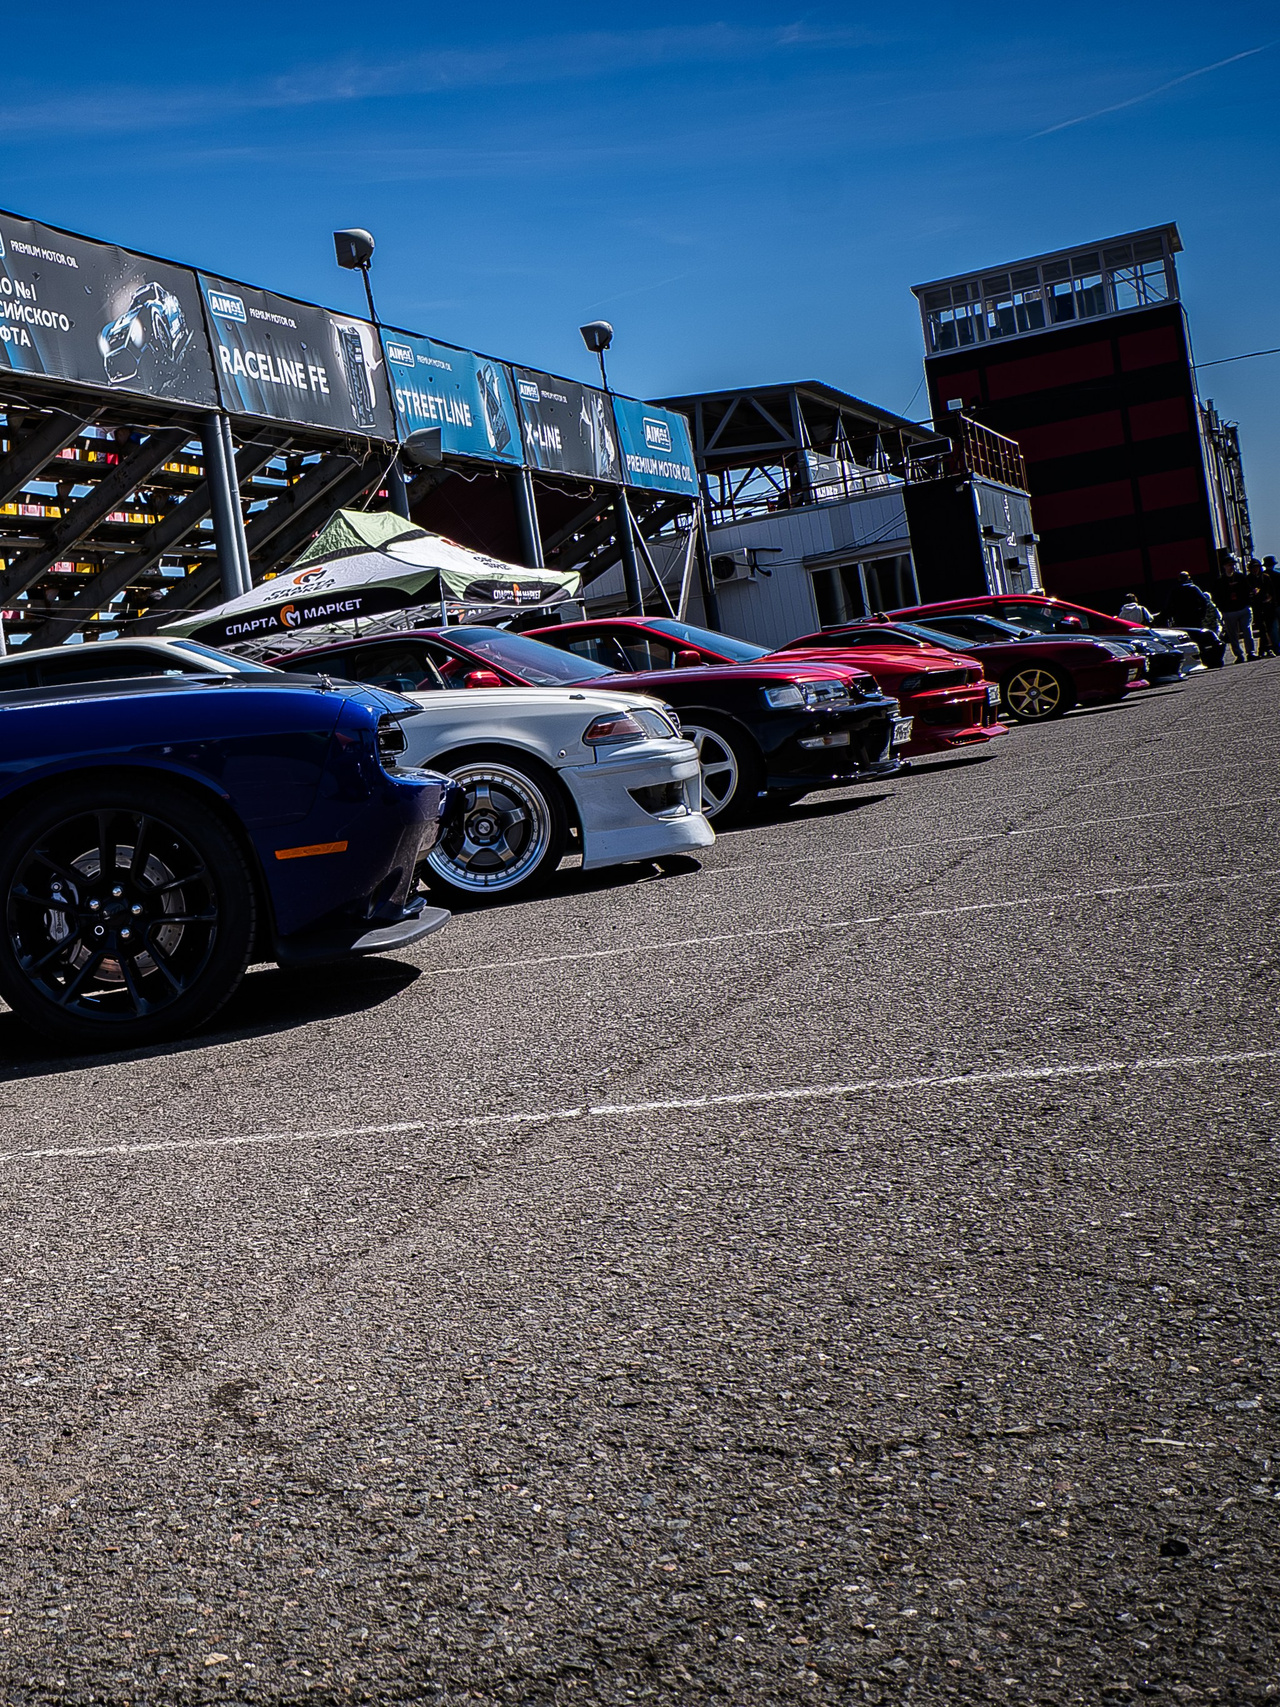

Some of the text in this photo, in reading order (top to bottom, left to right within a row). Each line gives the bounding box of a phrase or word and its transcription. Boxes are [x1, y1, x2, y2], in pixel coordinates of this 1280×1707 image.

[10, 240, 79, 269] PREMIUM MOTOR OIL
[219, 345, 308, 391] RACELINE
[308, 364, 330, 394] FE
[395, 388, 472, 427] STREETLINE
[524, 421, 562, 450] X-LINE
[626, 454, 693, 482] PREMIUM MOTOR OIL
[225, 616, 278, 636] СПАРТА
[304, 598, 362, 619] МАРКЕТ
